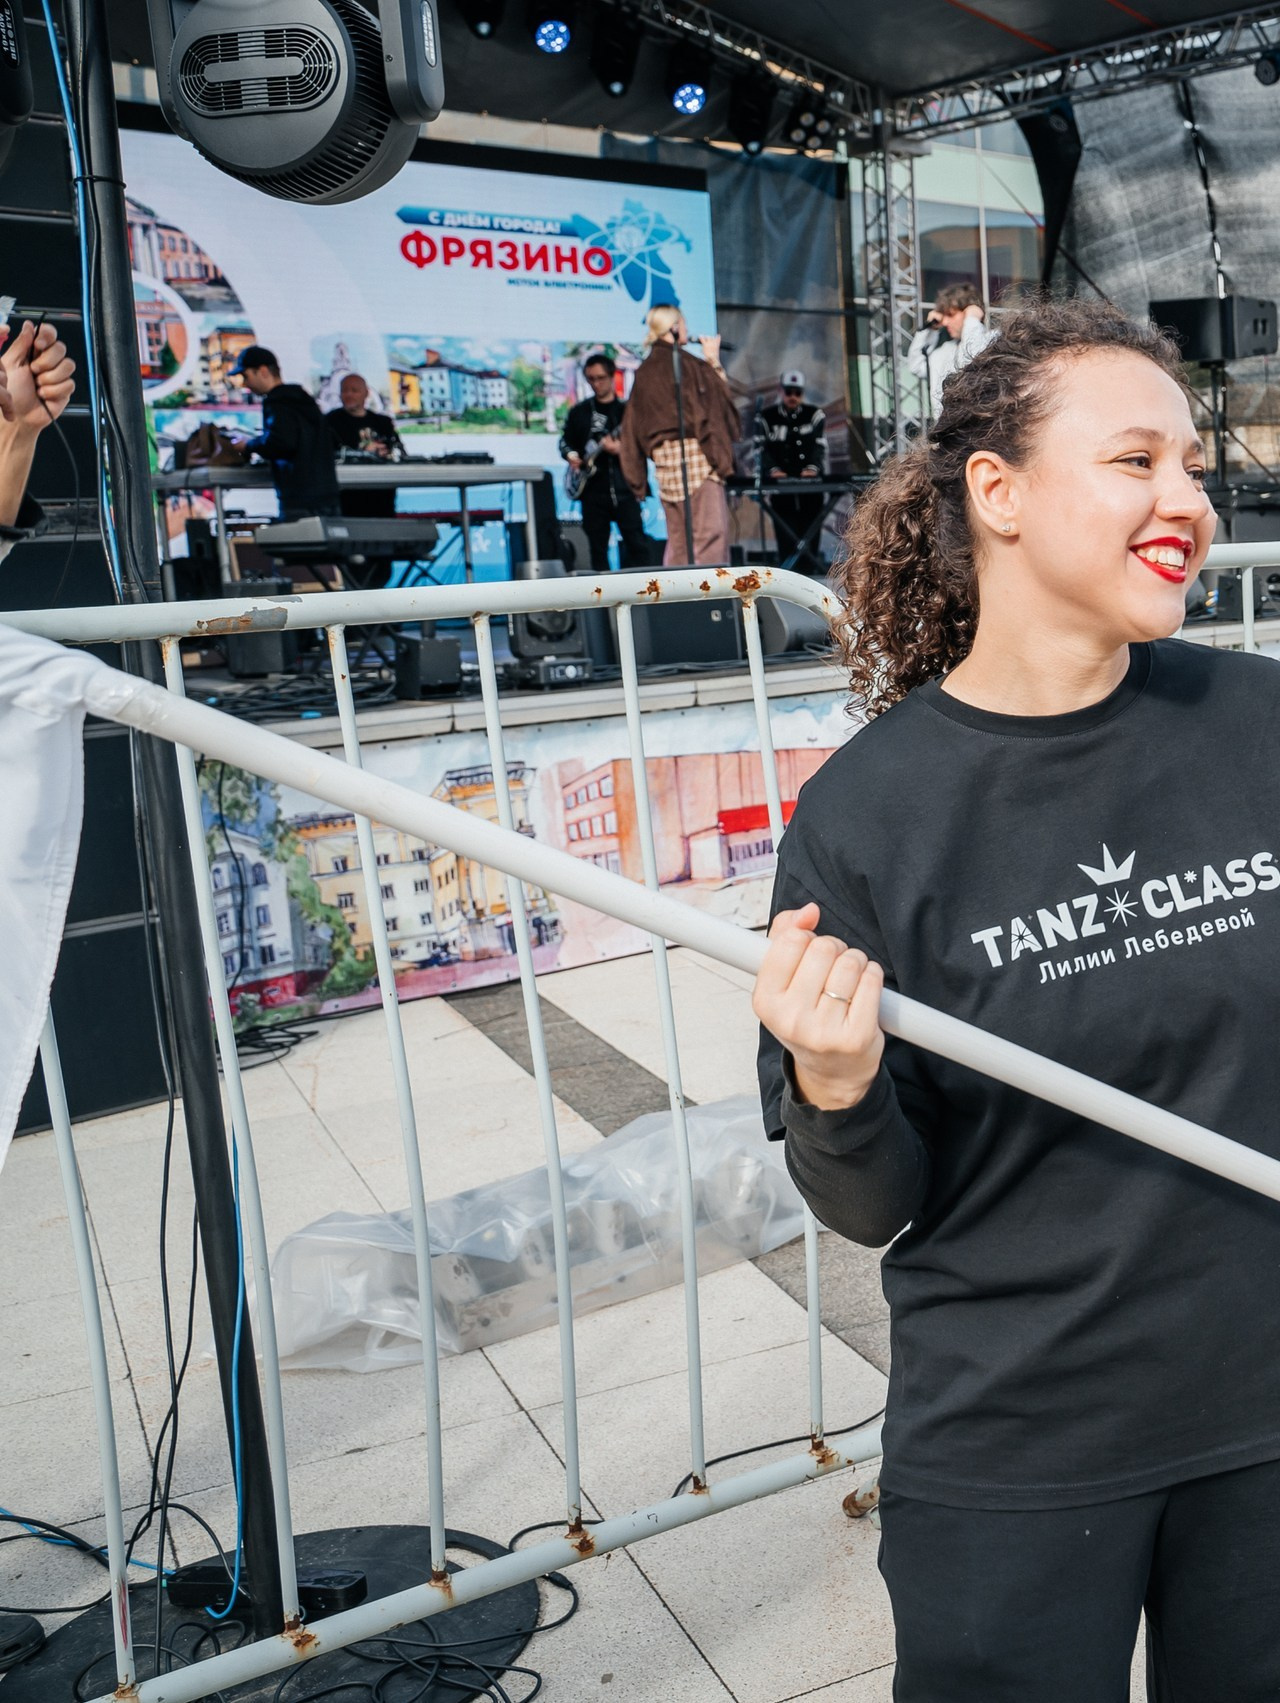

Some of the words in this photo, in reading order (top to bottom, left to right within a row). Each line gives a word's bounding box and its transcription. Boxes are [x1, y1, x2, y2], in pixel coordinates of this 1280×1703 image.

[428, 211, 440, 224] С
[443, 211, 490, 230] ДНЁМ
[492, 216, 561, 234] ГОРОДА!
[400, 230, 613, 277] ФРЯЗИНО
[970, 893, 1106, 968] TANZ
[1039, 948, 1116, 984] Лилии
[1123, 907, 1256, 959] Лебедевой
